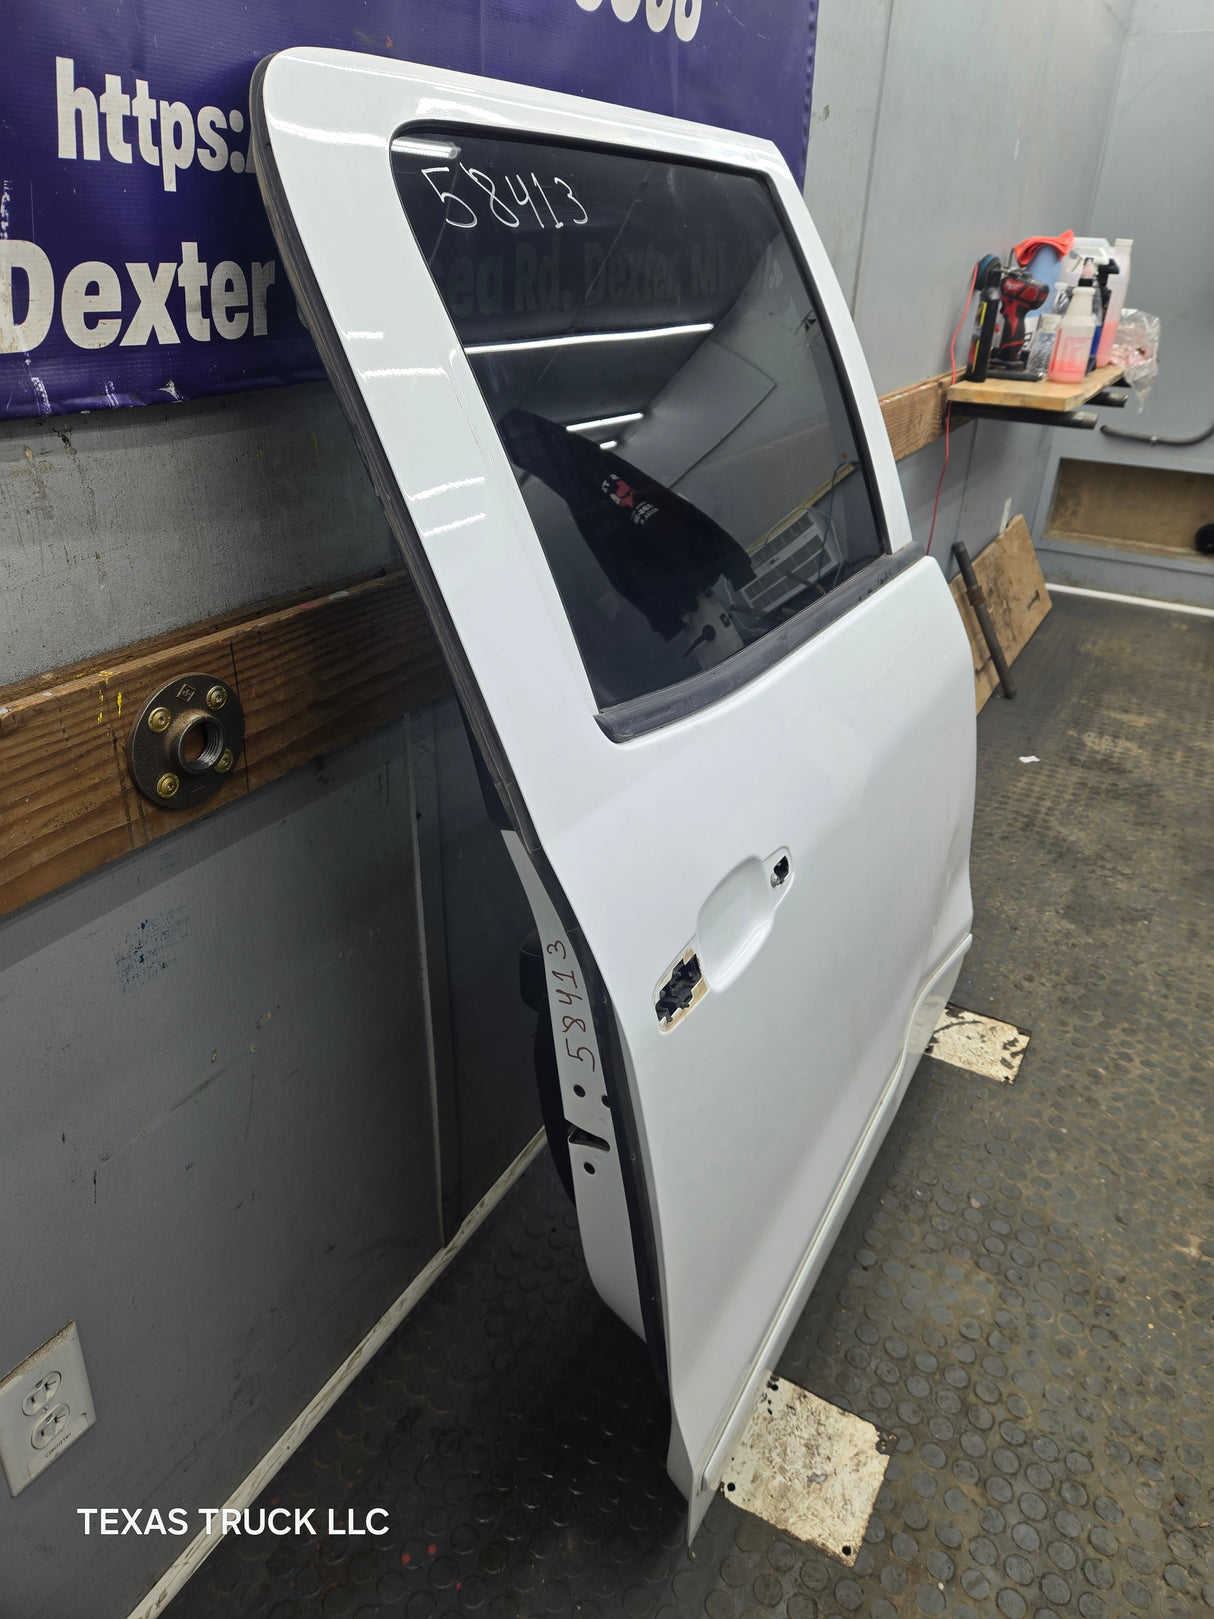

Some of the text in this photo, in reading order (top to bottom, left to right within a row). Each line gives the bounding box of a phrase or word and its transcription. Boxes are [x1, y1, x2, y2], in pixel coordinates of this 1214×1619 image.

[421, 162, 589, 228] 58413
[0, 239, 276, 354] Dexter
[430, 255, 503, 318] ea
[547, 940, 596, 1072] 58413
